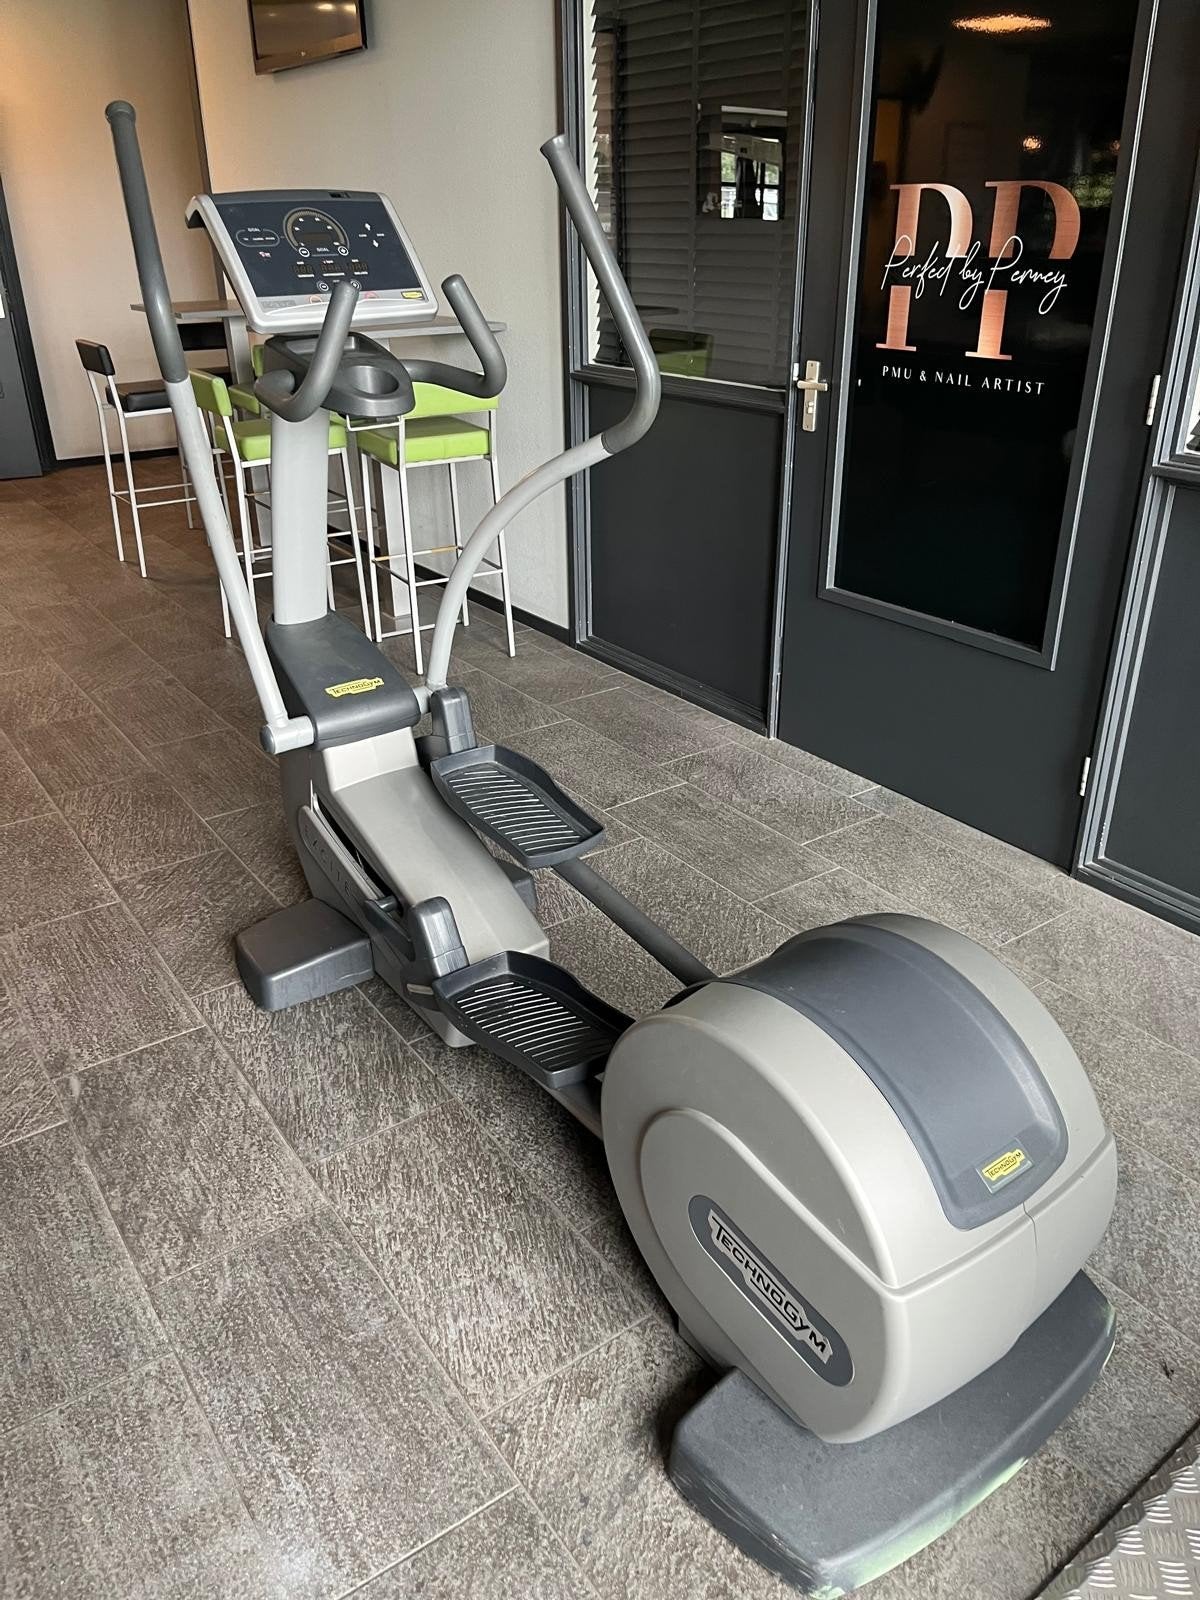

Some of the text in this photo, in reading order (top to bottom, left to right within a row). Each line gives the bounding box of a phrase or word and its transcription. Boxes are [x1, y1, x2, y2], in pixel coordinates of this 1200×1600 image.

[881, 235, 1068, 315] Perfect by Penney
[882, 365, 1045, 395] PMU & NAIL ARTIST
